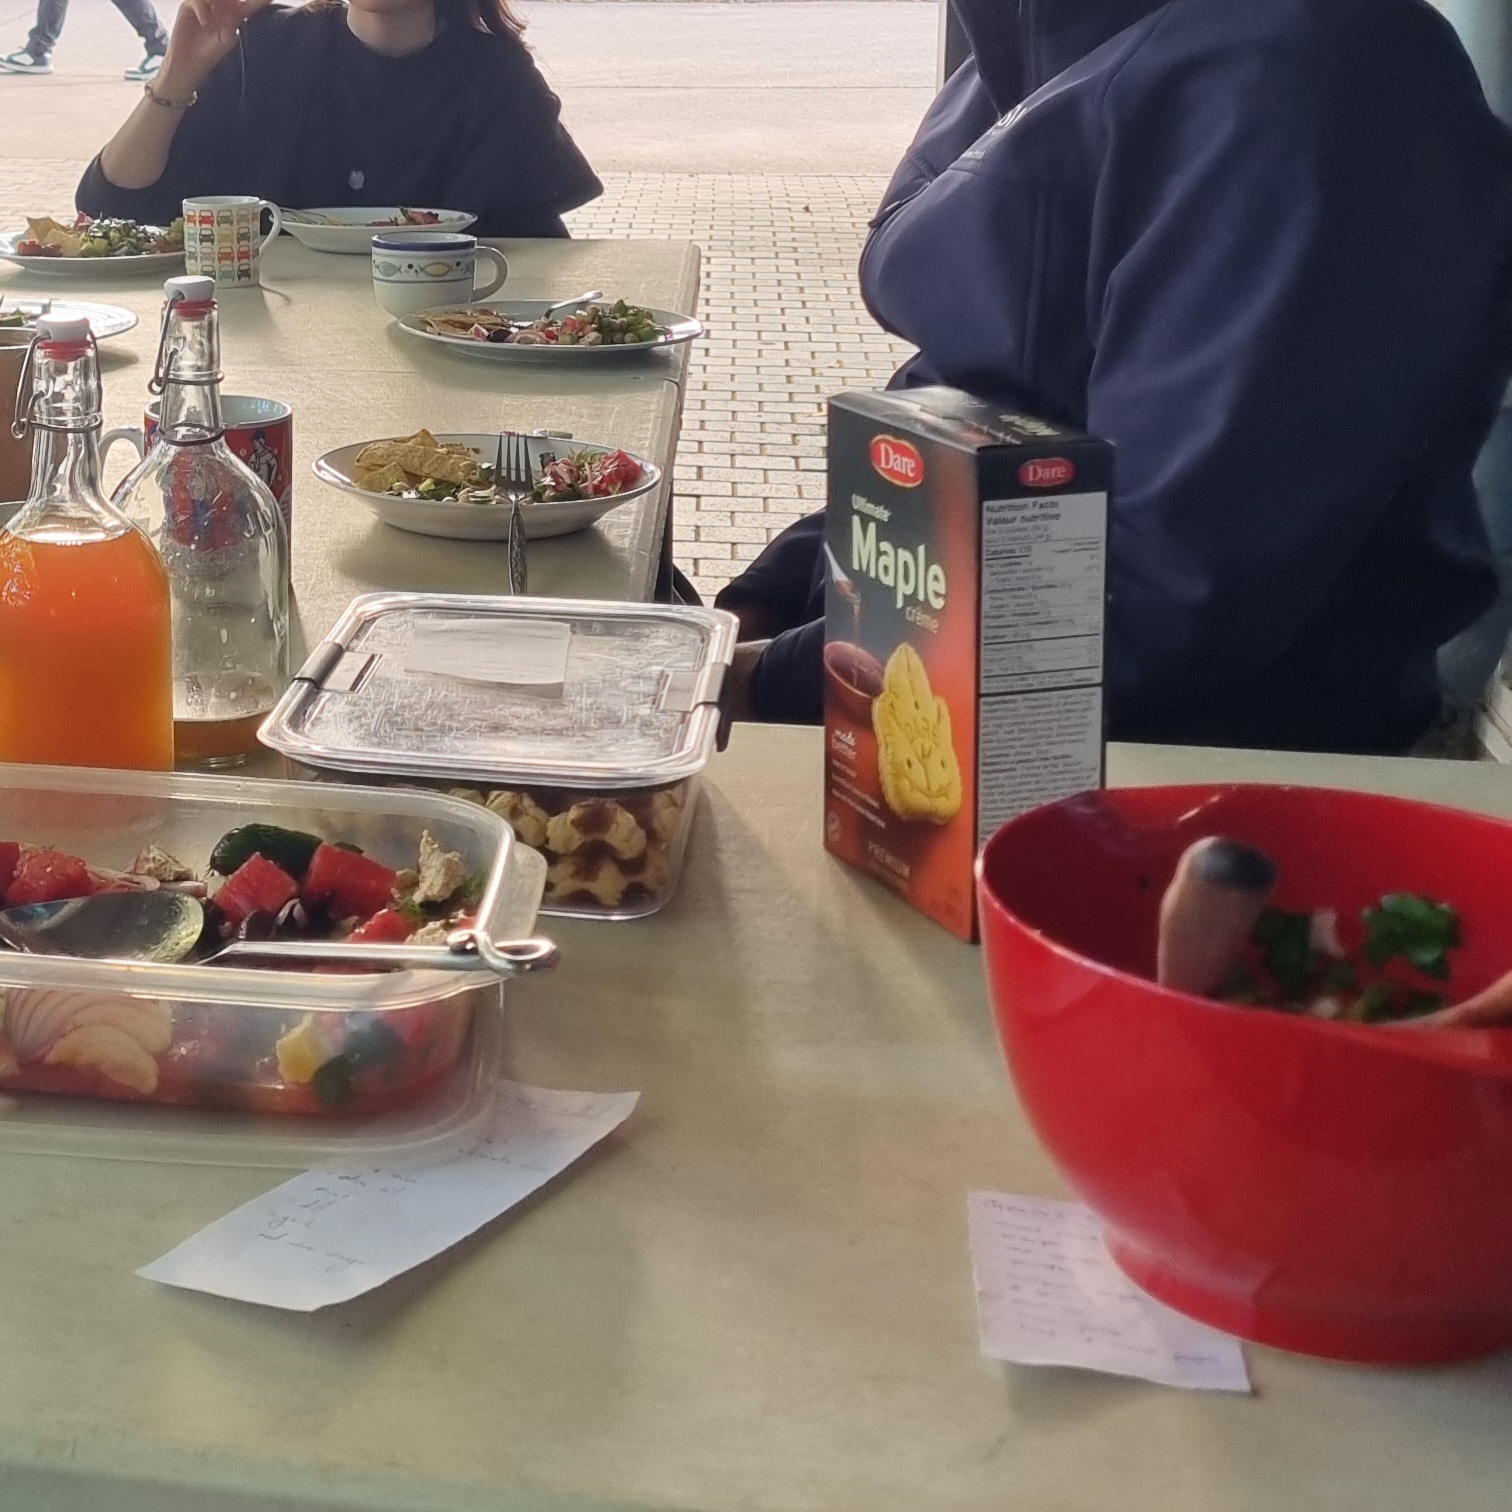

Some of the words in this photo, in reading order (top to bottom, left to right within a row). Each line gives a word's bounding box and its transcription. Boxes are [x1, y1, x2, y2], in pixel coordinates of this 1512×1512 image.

[880, 443, 916, 477] Dare
[1027, 464, 1067, 482] Dare
[851, 514, 947, 610] Maple
